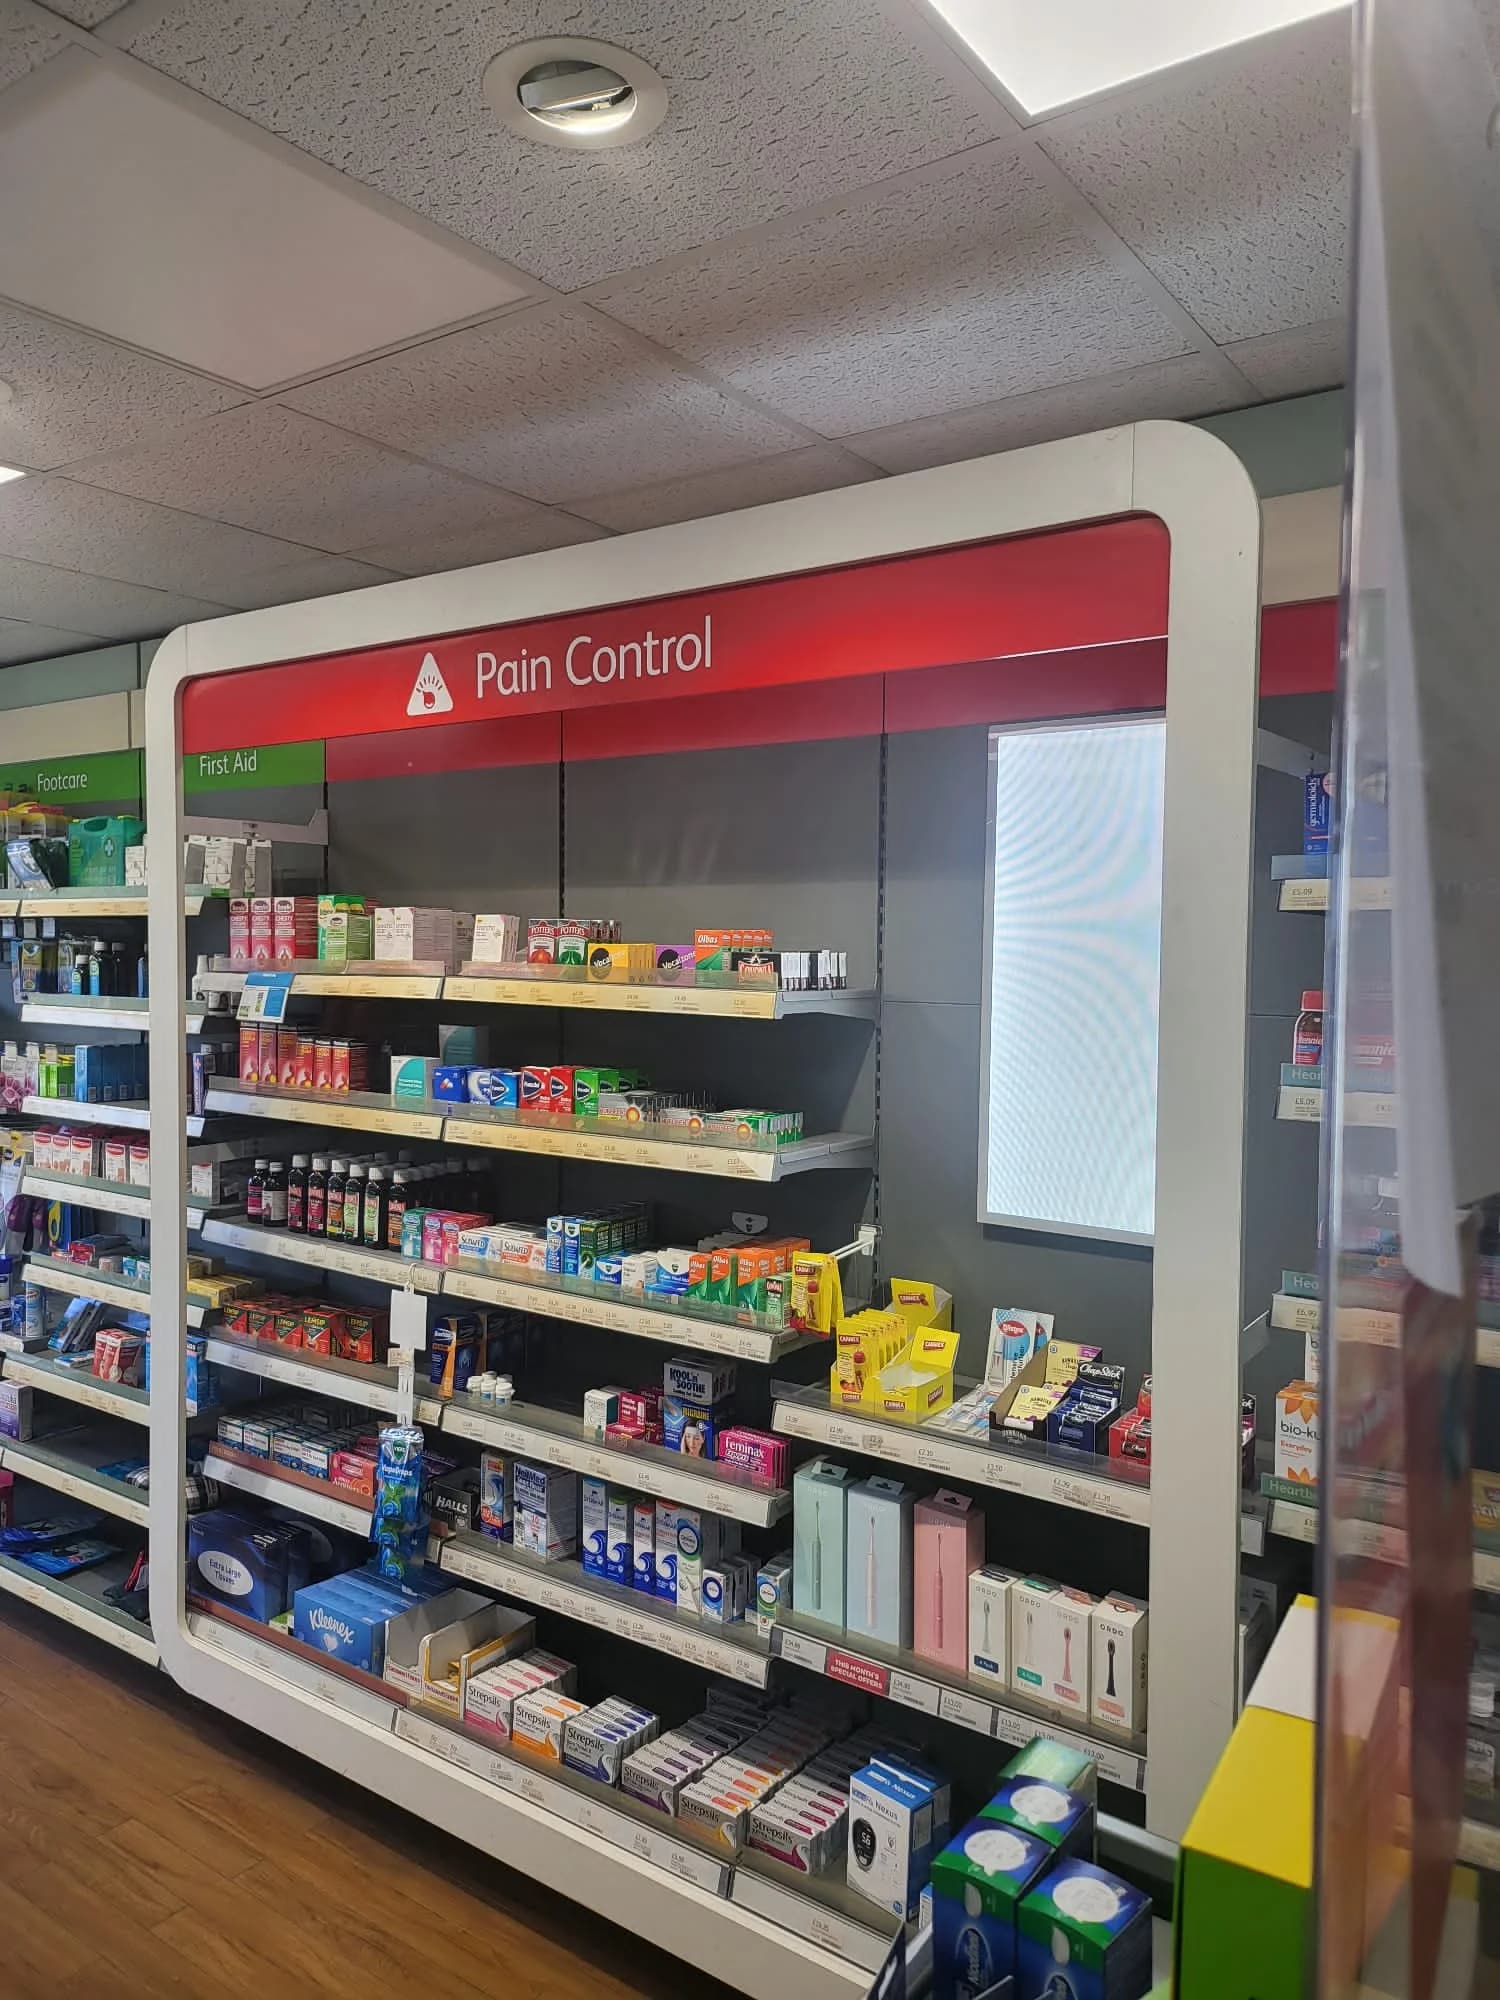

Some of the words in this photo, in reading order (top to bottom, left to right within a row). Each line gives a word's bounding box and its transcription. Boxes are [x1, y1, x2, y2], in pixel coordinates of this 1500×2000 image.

[476, 648, 552, 698] Pain
[565, 615, 712, 686] Control
[199, 755, 230, 777] First
[233, 750, 257, 774] Aid
[37, 772, 88, 792] Footcare
[697, 934, 718, 944] Olbas
[304, 1315, 325, 1327] LEMSIP
[347, 1317, 368, 1328] LEMSIP
[1079, 1362, 1121, 1379] ChapStick
[676, 1379, 706, 1394] SOOTHE
[726, 1436, 765, 1459] Feminax
[436, 1495, 468, 1514] HALLS
[309, 1607, 356, 1644] Kleenex
[1099, 1623, 1124, 1637] ORDO
[830, 1665, 857, 1680] SPECIAL
[857, 1675, 883, 1689] OFFERS
[835, 1659, 850, 1669] THIS
[850, 1664, 880, 1680] MONTH'S
[468, 1685, 500, 1707] Strepsils
[516, 1705, 551, 1729] Strepsils
[567, 1727, 606, 1753] Strepsils
[624, 1766, 660, 1791] Strepsils
[681, 1797, 720, 1824] Strepsils
[875, 1800, 899, 1821] Nexus
[752, 1818, 793, 1845] Strepsils
